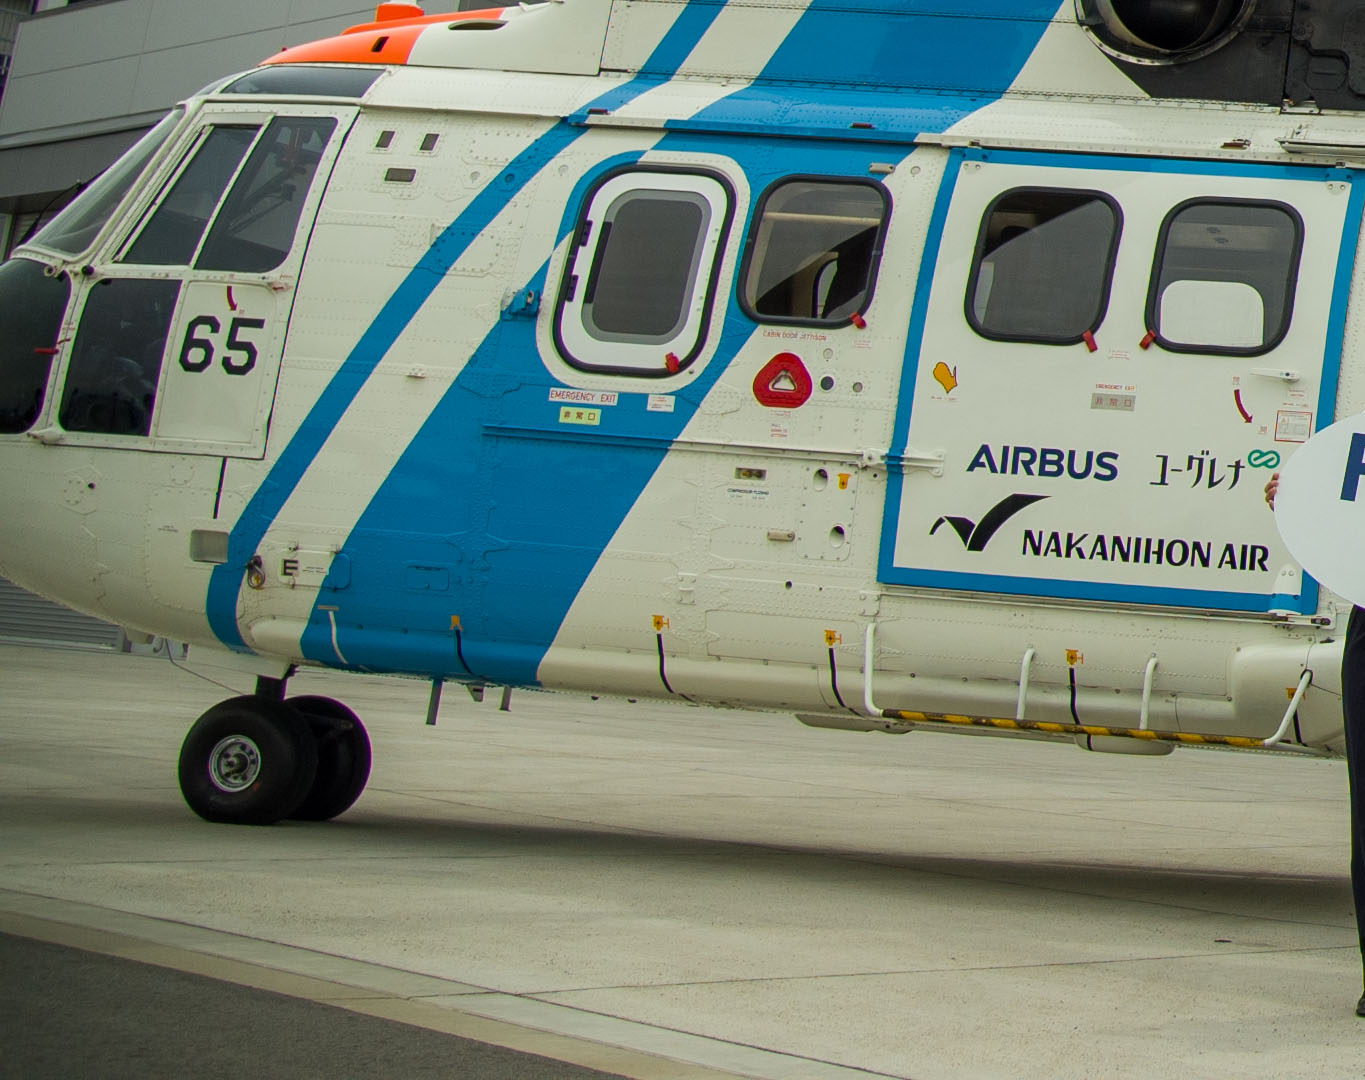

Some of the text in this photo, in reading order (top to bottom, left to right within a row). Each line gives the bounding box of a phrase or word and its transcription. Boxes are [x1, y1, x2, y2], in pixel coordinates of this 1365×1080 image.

[179, 316, 265, 376] 65
[550, 389, 617, 404] EMERGENCY EXIT
[563, 410, 596, 421] 非常口
[966, 444, 1119, 481] AIRBUS
[1150, 449, 1246, 491] ユーグレナ
[1022, 529, 1270, 572] NAKANIHON AIR
